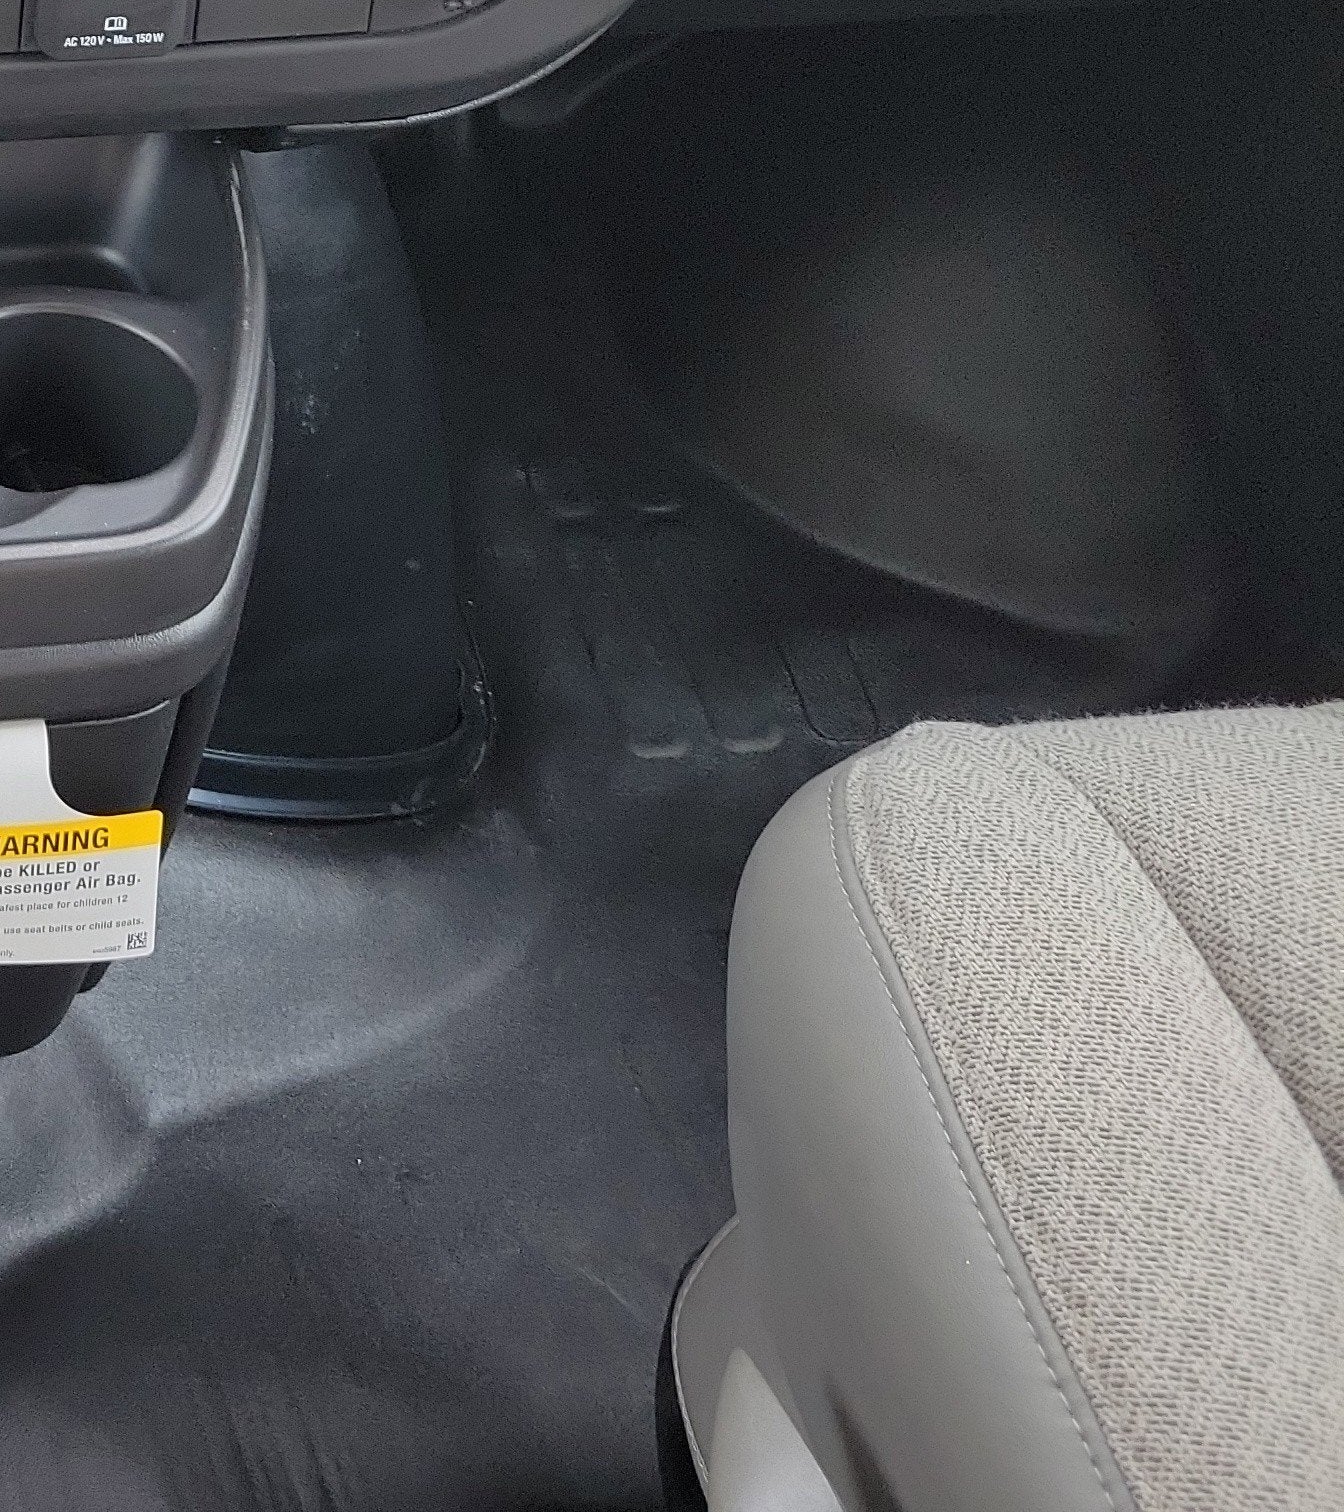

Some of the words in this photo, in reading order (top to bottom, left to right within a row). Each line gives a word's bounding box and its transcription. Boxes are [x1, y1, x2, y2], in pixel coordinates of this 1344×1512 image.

[64, 37, 78, 47] AC
[113, 34, 133, 44] Max
[19, 861, 77, 877] KILLED
[83, 861, 100, 872] or
[76, 876, 100, 889] Air
[105, 873, 141, 886] Bag.
[26, 902, 53, 912] place
[57, 900, 71, 909] for
[73, 897, 113, 908] children
[117, 894, 128, 904] 12
[24, 925, 45, 934] seat
[48, 924, 73, 933] belts
[88, 920, 113, 930] child
[116, 917, 144, 928] seats.
